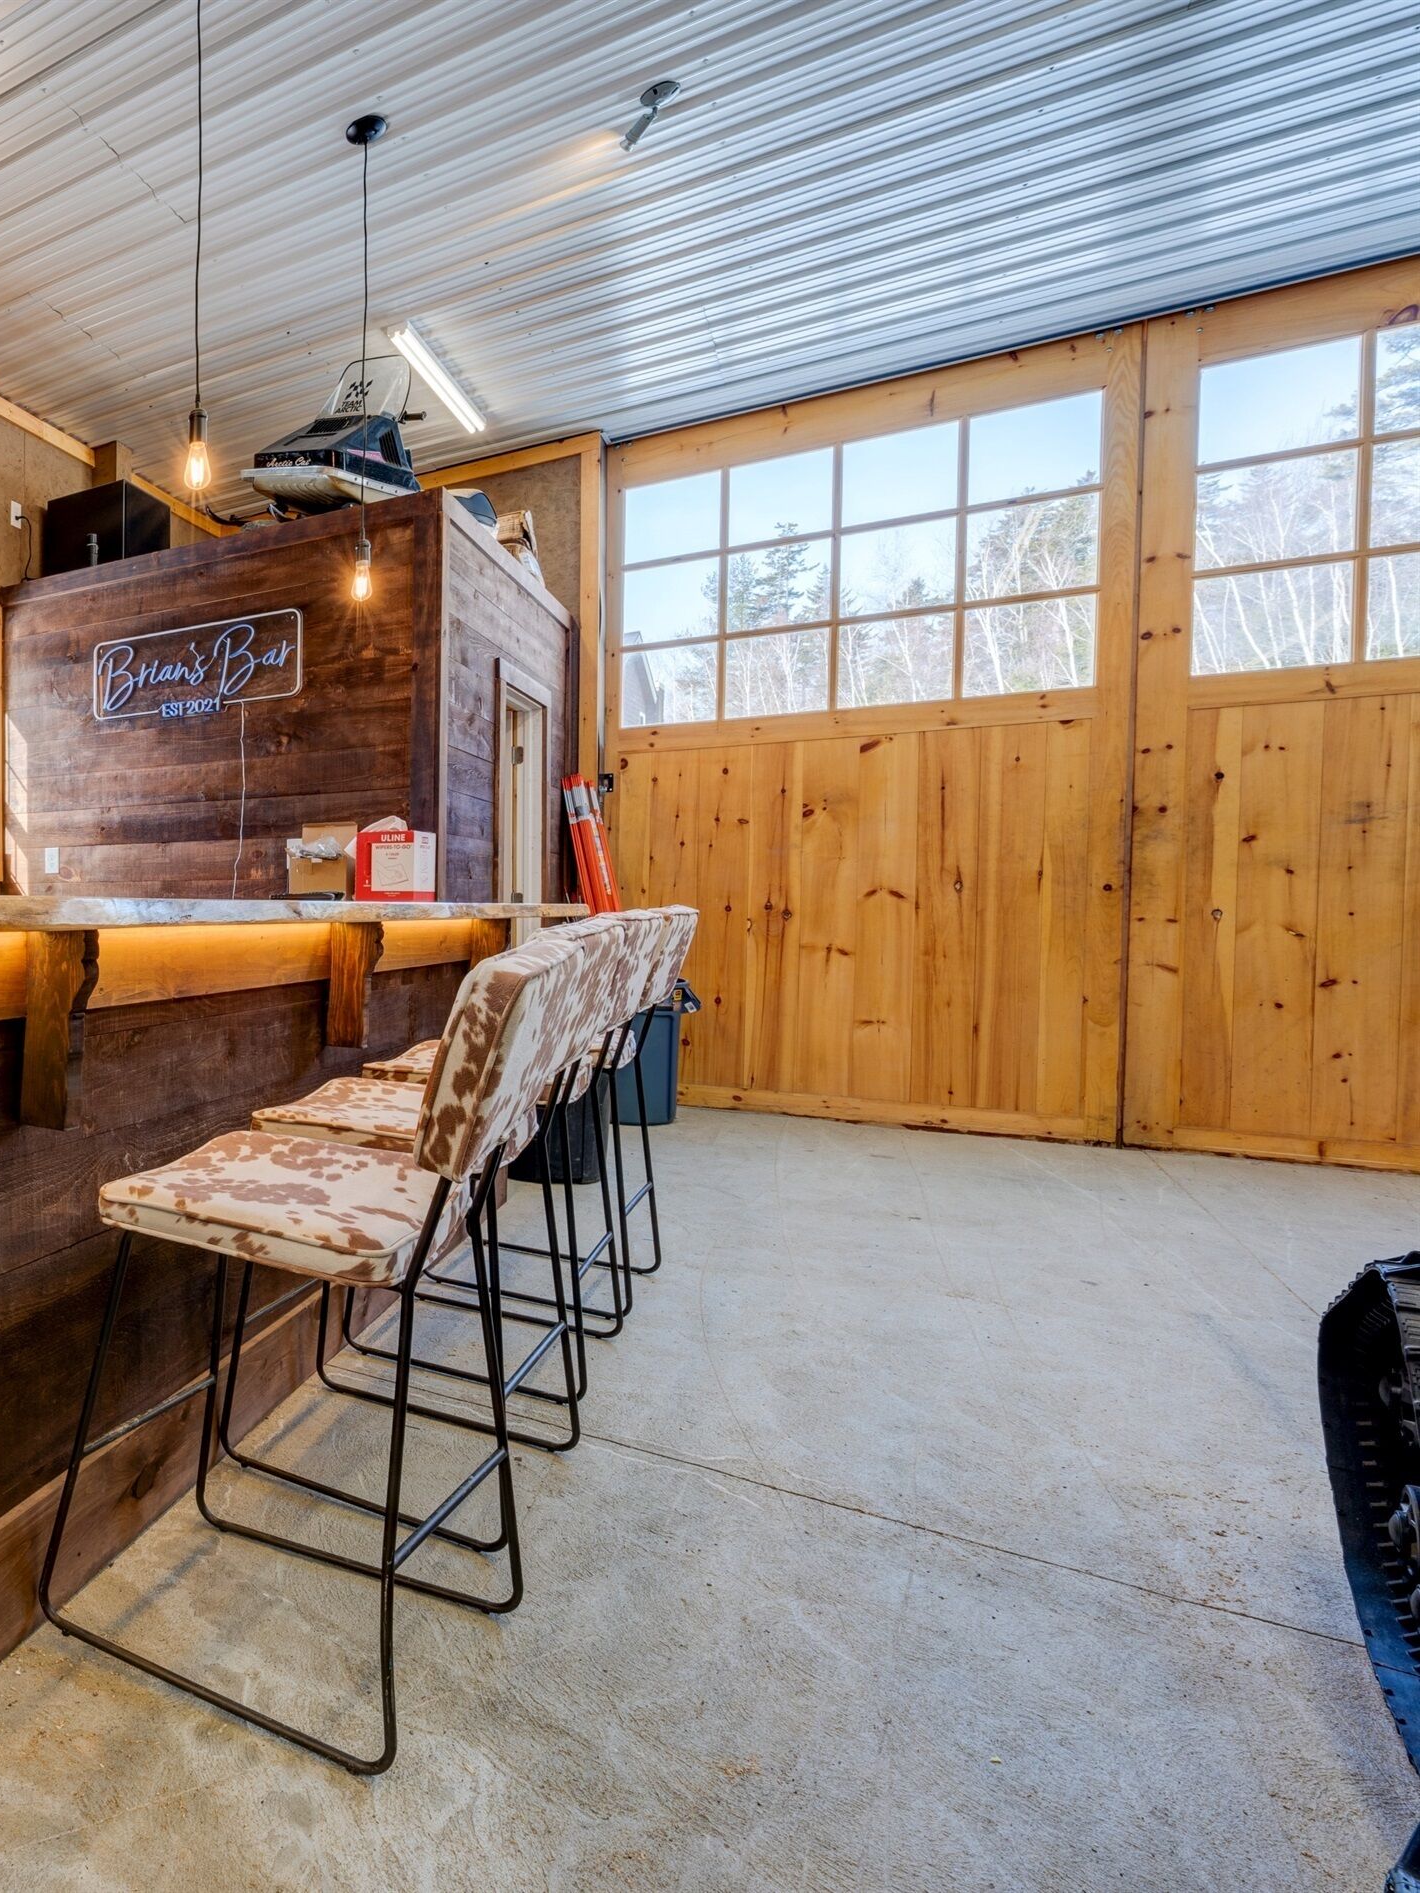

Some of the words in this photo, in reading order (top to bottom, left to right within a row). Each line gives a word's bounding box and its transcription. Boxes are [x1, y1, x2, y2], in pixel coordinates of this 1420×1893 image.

[266, 458, 293, 467] Arctic
[294, 456, 311, 466] Cat
[98, 642, 207, 711] Brian's
[214, 624, 297, 697] Bar
[381, 834, 406, 842] ULINE
